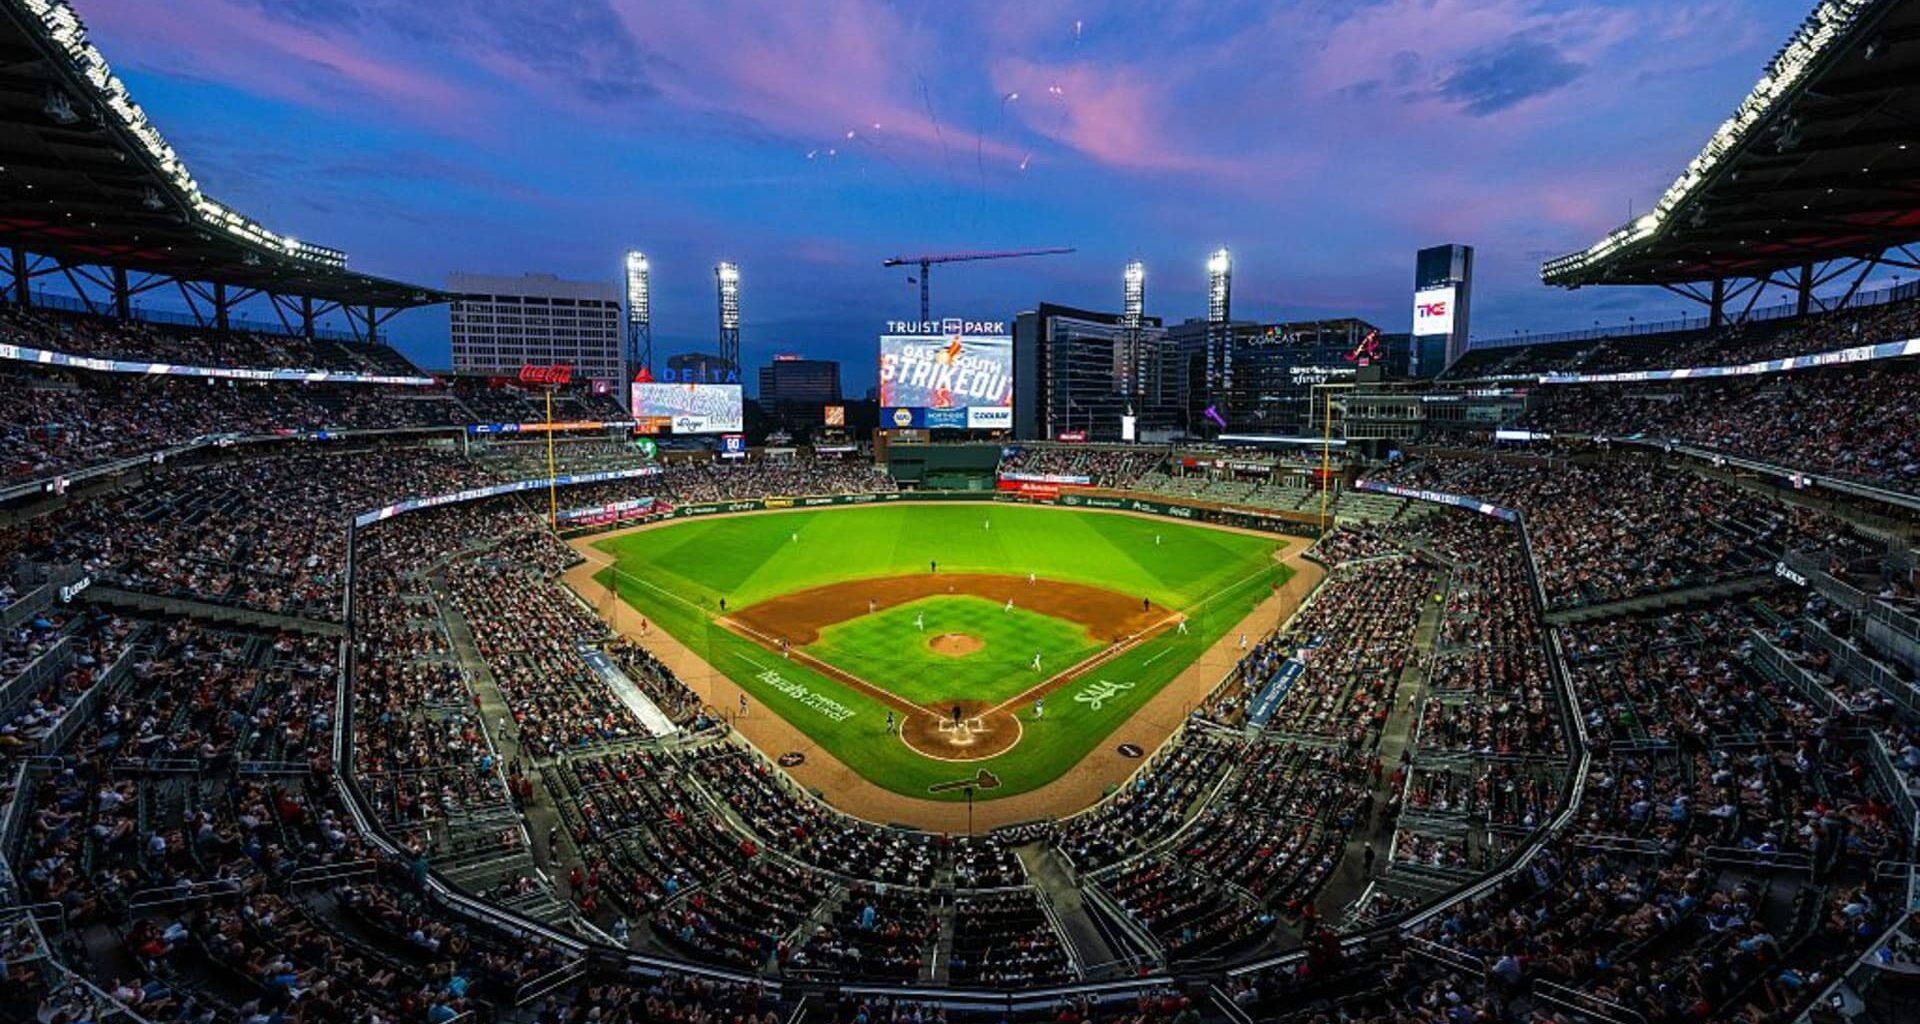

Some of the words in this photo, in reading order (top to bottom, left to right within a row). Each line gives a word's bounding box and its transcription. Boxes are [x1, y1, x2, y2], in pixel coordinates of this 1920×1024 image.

[1417, 302, 1446, 318] TKE
[886, 321, 940, 333] TRUIST
[965, 321, 1004, 334] PARK
[903, 345, 935, 361] GAS
[951, 355, 1002, 373] SOUTH
[663, 368, 738, 383] DETA
